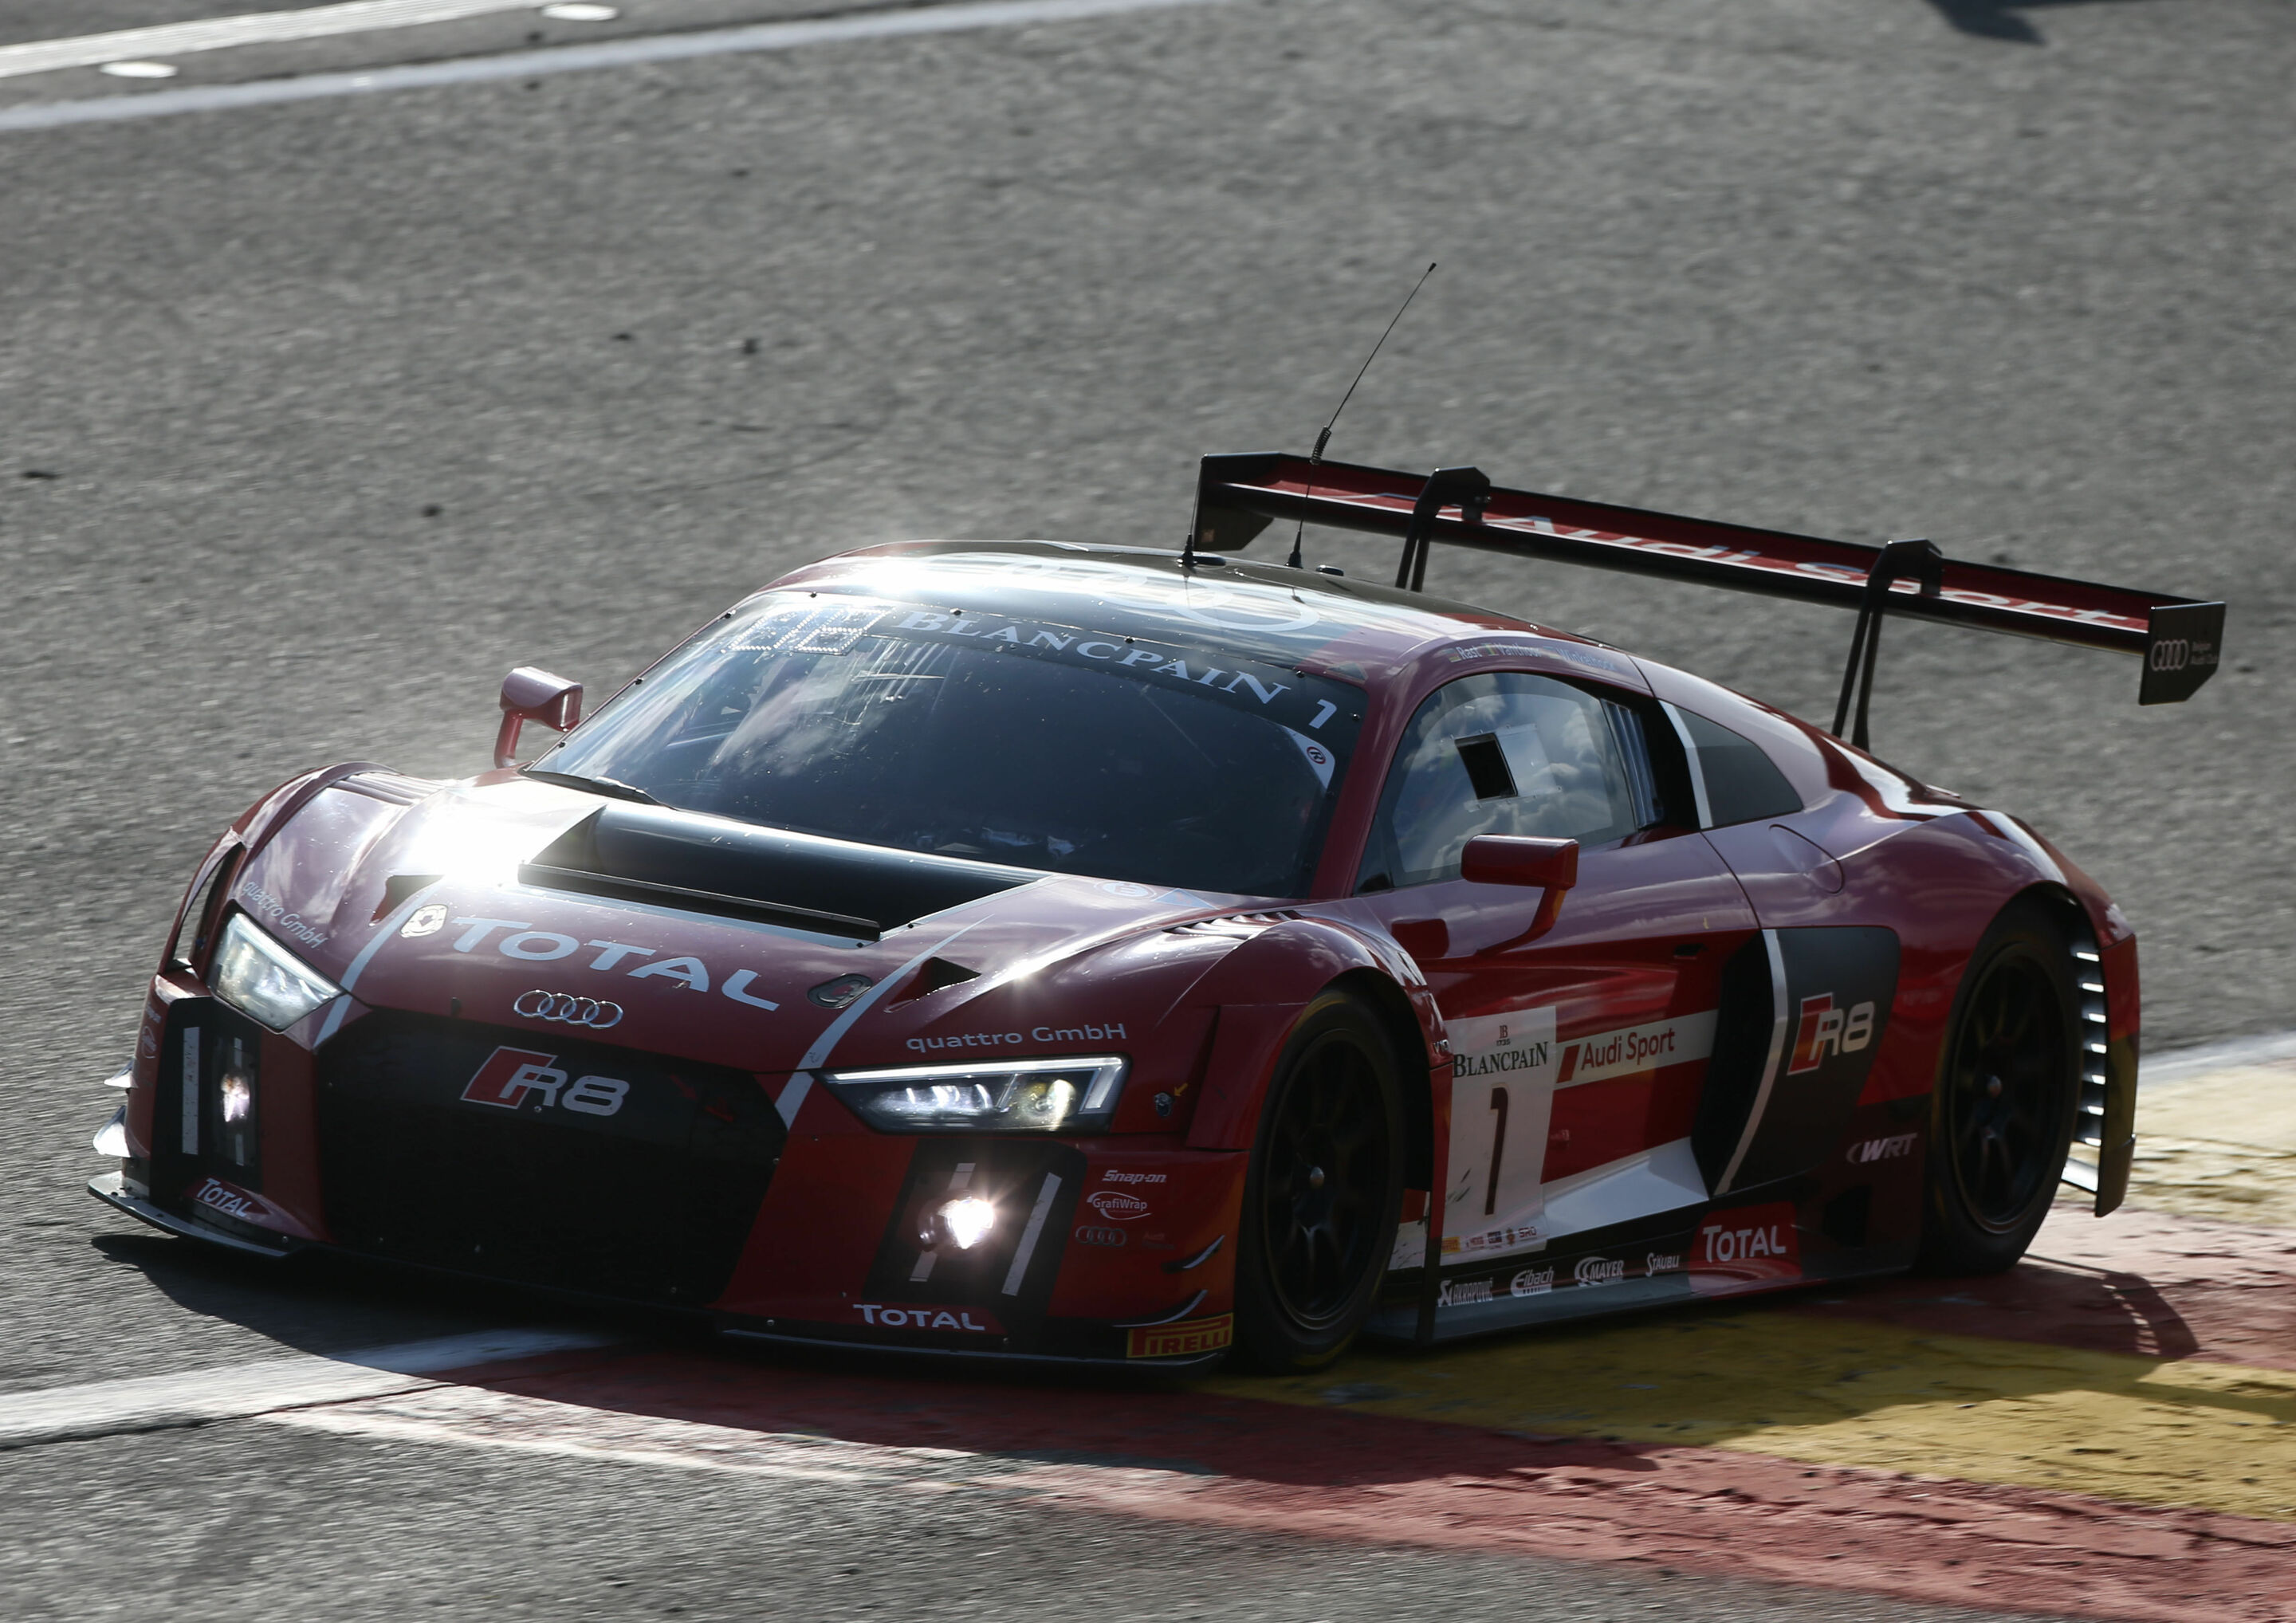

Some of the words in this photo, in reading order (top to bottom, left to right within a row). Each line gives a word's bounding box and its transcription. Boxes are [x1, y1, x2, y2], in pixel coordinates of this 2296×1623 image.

[1795, 561, 2129, 625] Sort
[1455, 646, 1482, 661] Rast
[1308, 698, 1338, 729] 1
[242, 881, 285, 917] quattro
[280, 914, 328, 949] GmbH
[451, 917, 780, 1012] TOTAL
[906, 1032, 1023, 1054] quattro
[1031, 1022, 1127, 1043] GmbH
[1581, 1035, 1623, 1071] Audi
[1626, 1027, 1676, 1066] Sport
[1807, 1000, 1875, 1062] R8
[494, 1060, 631, 1117] R8
[1484, 1087, 1509, 1216] 1
[1859, 1132, 1918, 1163] WRT
[1102, 1169, 1167, 1185] Snap-on
[196, 1177, 253, 1218] TOTAL
[1093, 1197, 1148, 1211] GrafiWrap
[1703, 1224, 1787, 1263] TOTAL
[1511, 1265, 1554, 1291] Eibach
[1589, 1259, 1625, 1280] MAYER
[852, 1303, 986, 1331] TOTAL
[1132, 1316, 1231, 1356] PIRELLI
